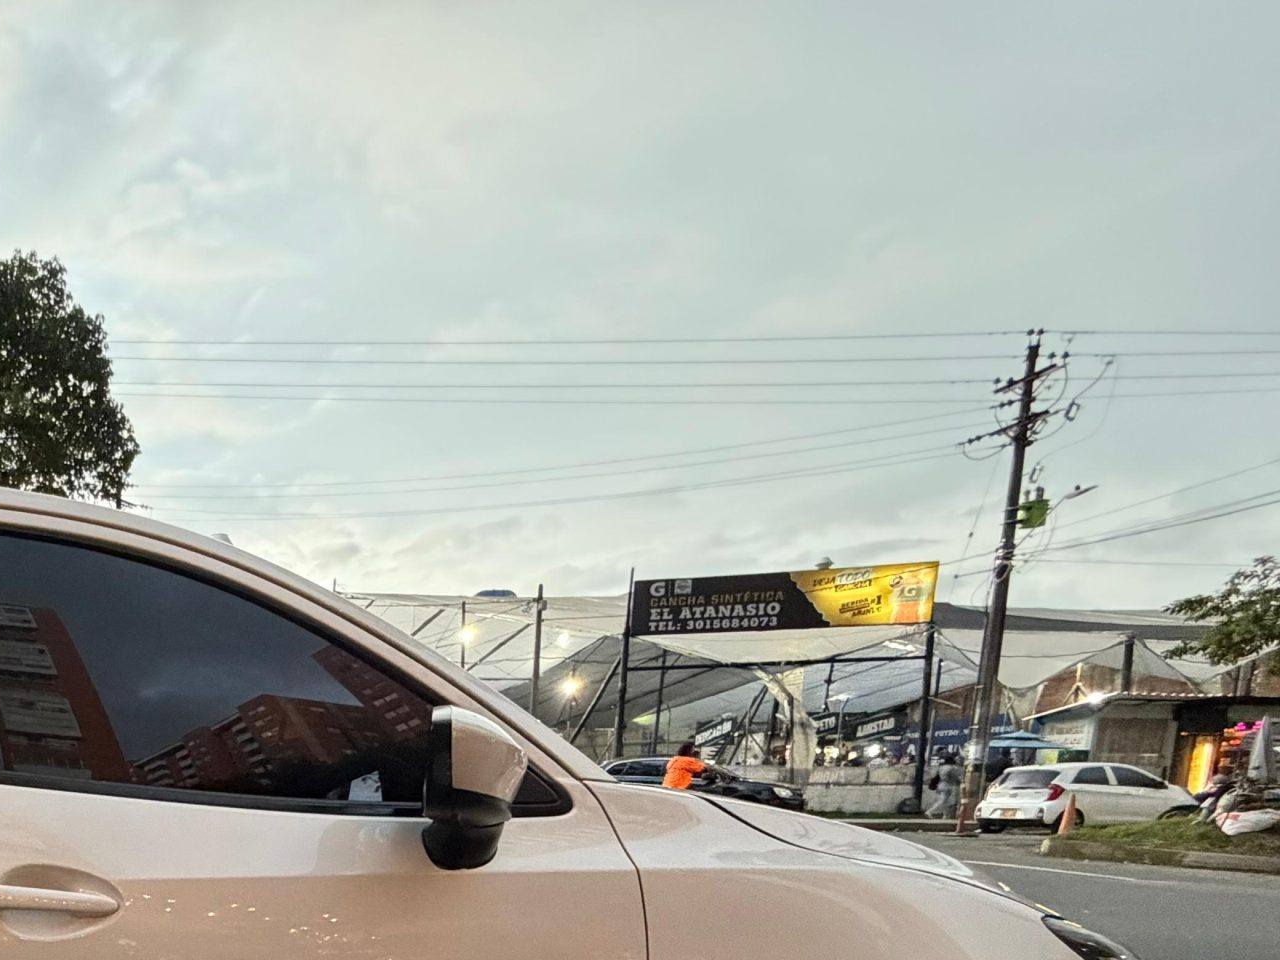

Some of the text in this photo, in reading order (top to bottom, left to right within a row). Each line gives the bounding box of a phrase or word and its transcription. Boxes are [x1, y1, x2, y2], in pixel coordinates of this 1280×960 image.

[650, 595, 705, 607] CANCHA
[649, 602, 781, 621] EL ATANASIO
[648, 616, 778, 632] TEL: 3015684073
[856, 717, 895, 738] AMISTAD
